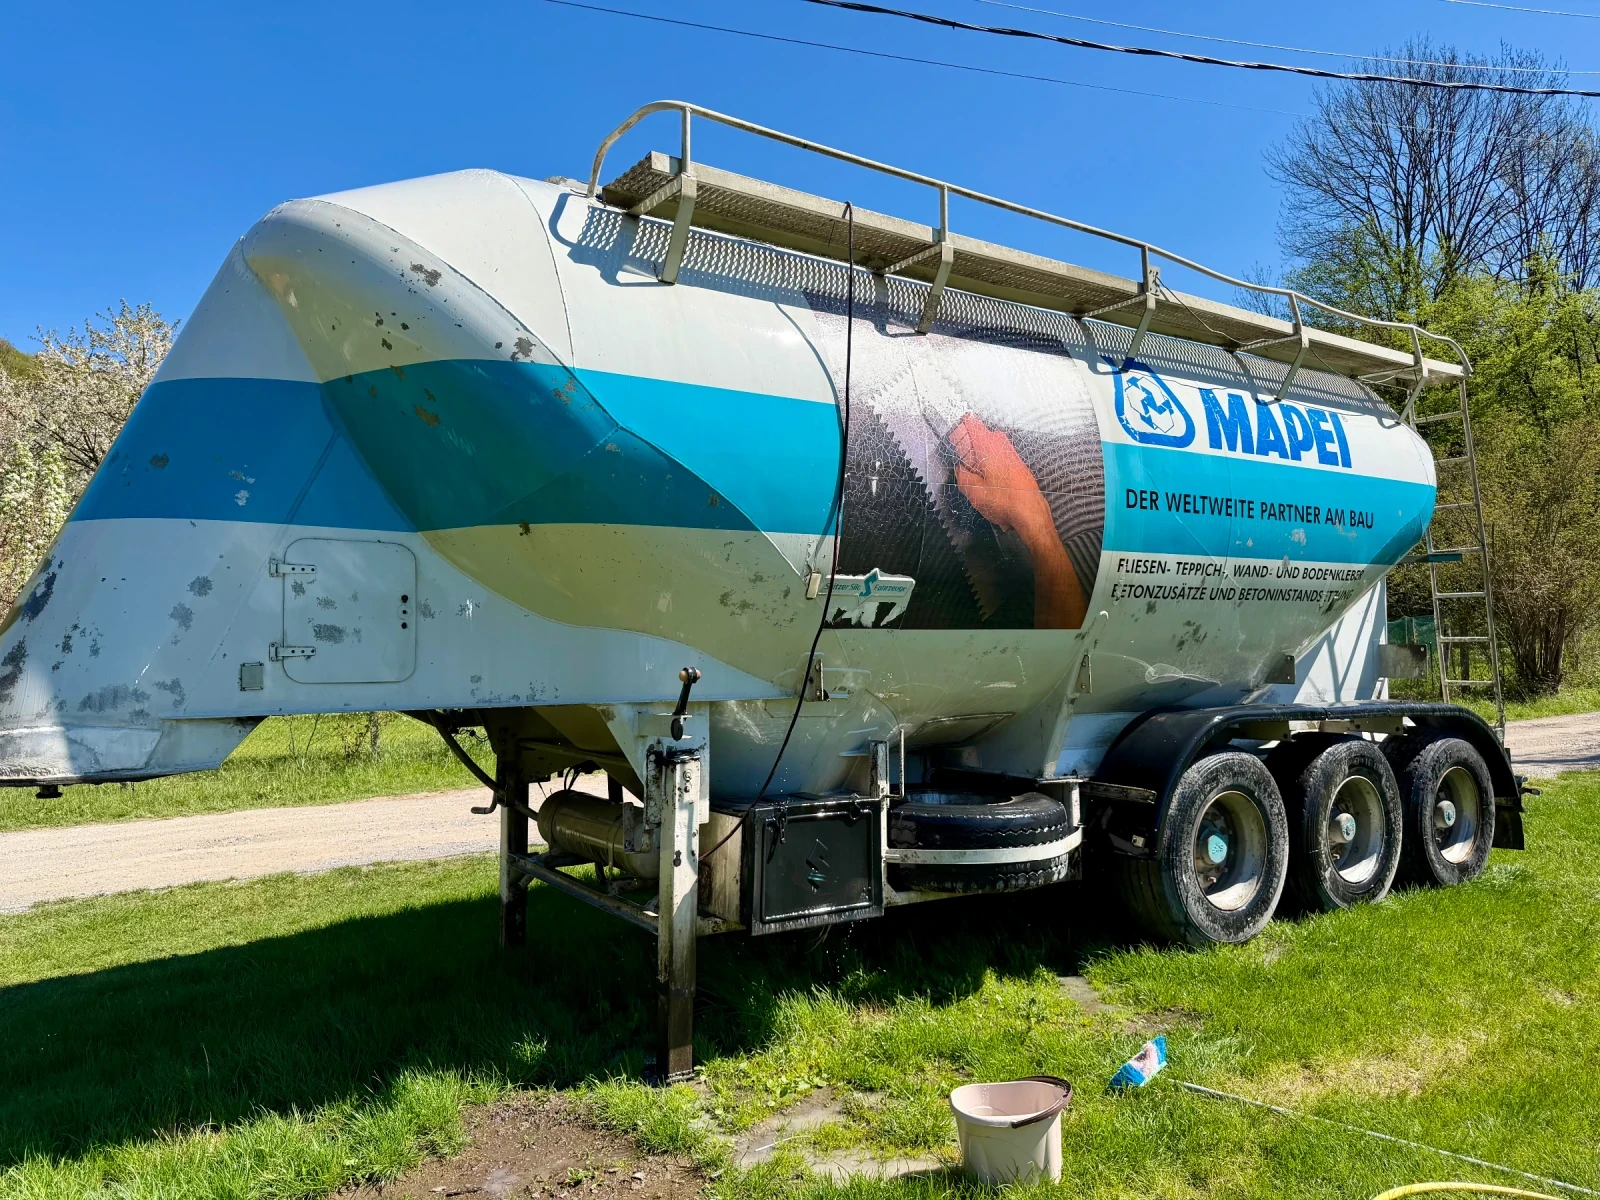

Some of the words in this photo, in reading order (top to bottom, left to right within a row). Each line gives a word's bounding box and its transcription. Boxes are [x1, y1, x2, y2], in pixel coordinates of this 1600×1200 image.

[1199, 388, 1352, 469] MAPEI
[1126, 488, 1159, 511] DER
[1165, 492, 1254, 519] WELTWEITE
[1261, 501, 1321, 525] PARTNER
[1325, 507, 1346, 526] AM
[1350, 510, 1374, 529] BAU
[1117, 558, 1171, 575] FLIESEN-
[1233, 564, 1273, 578] WAND-
[1276, 566, 1300, 579] UND
[1302, 567, 1364, 582] BODENKLEBER
[823, 582, 849, 592] Sitzer
[1209, 587, 1236, 601] UND
